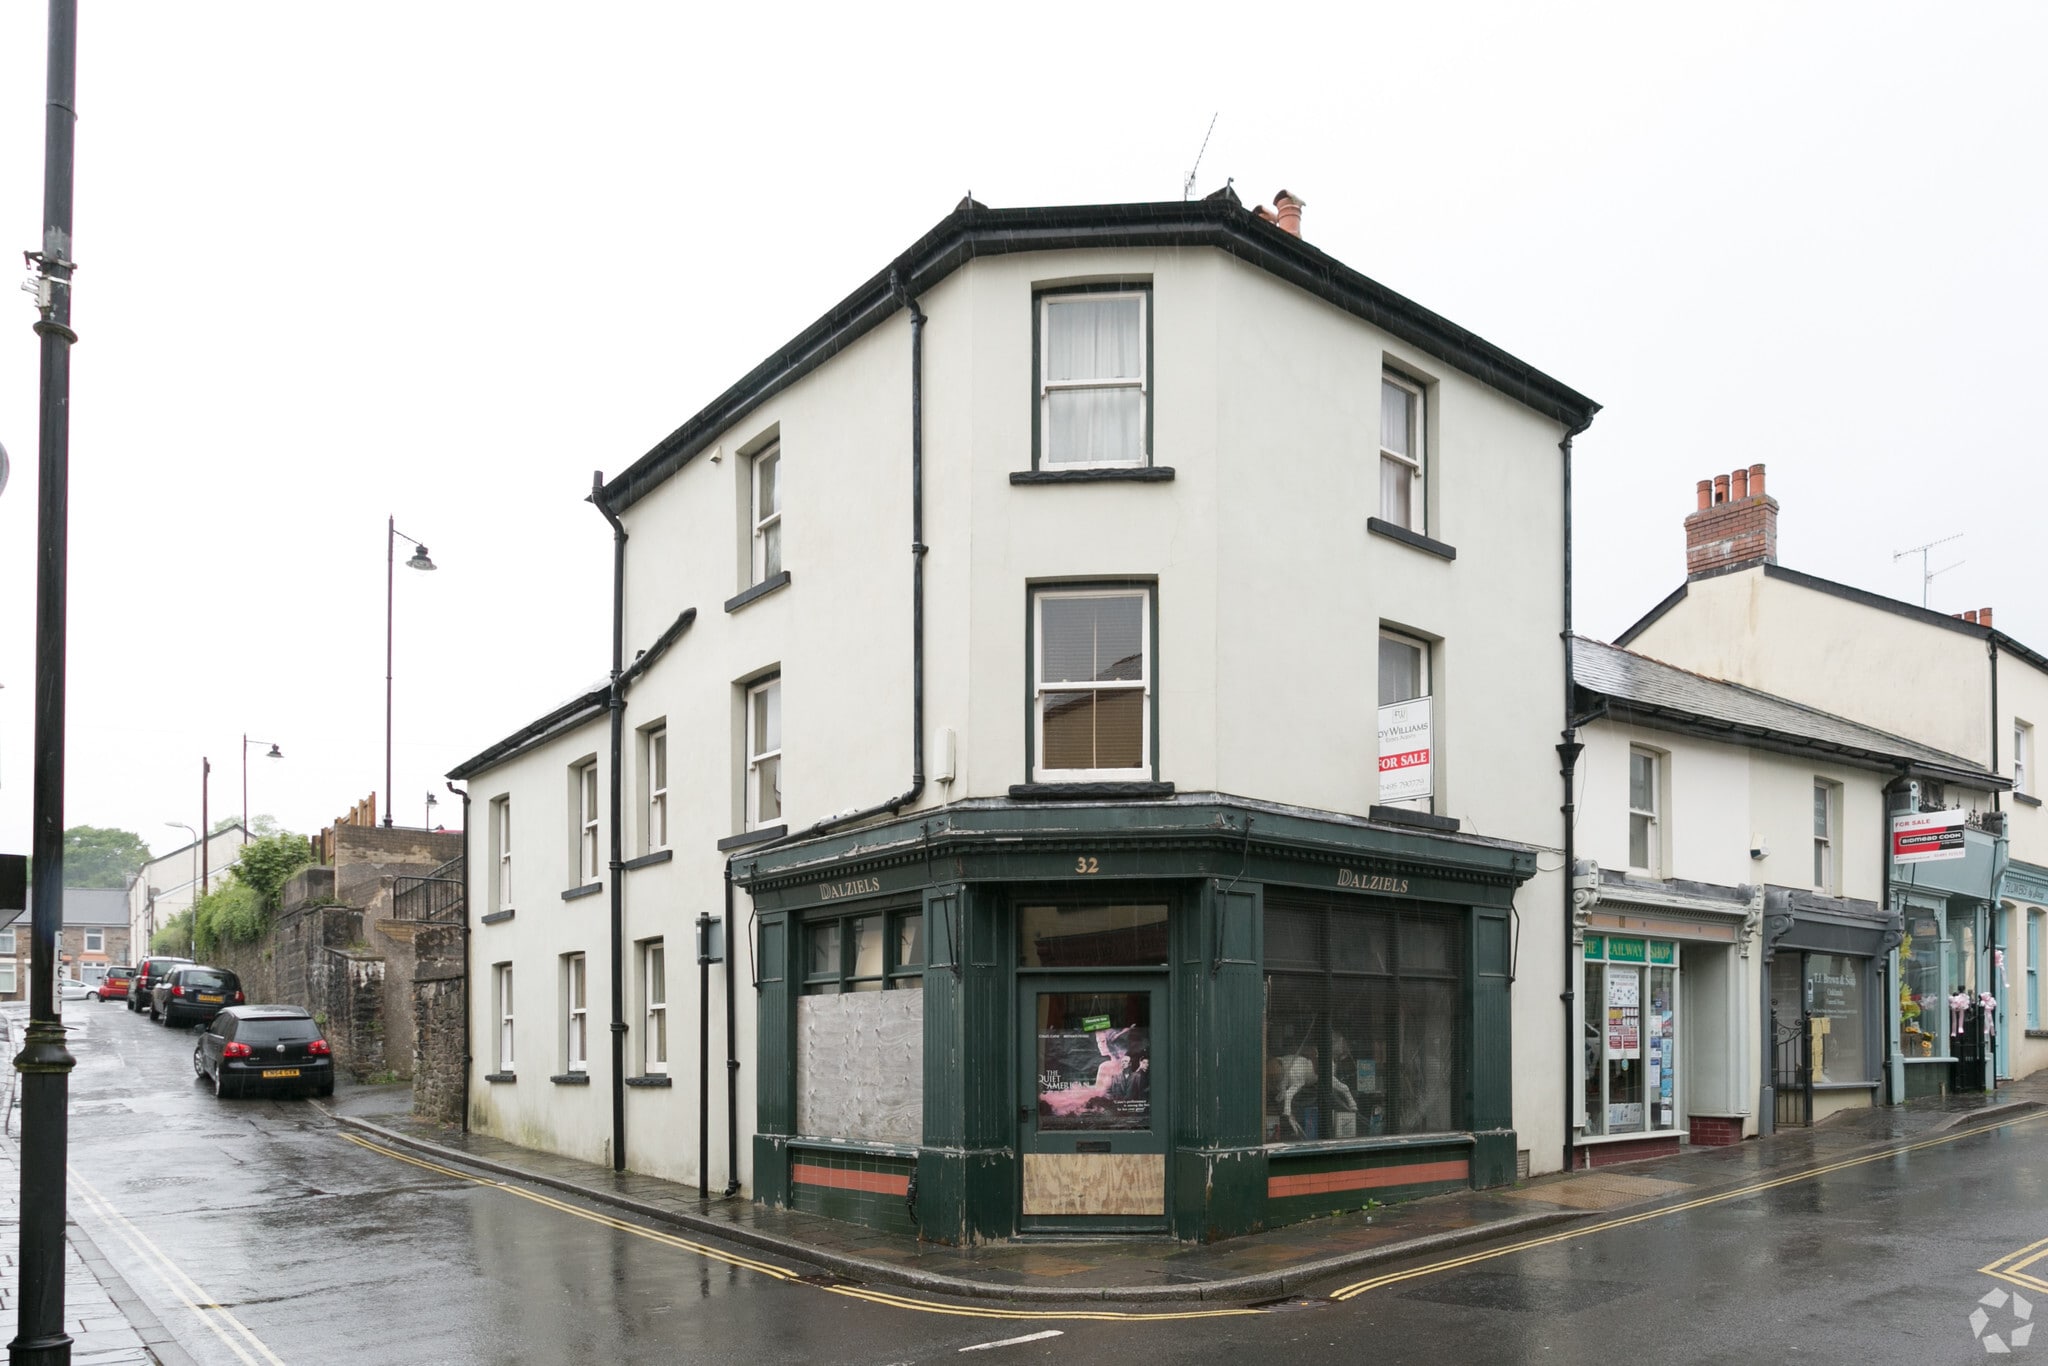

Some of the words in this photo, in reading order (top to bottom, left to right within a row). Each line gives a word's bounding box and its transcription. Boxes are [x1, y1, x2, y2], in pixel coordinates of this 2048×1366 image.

[1389, 722, 1428, 735] WILLIAMS
[1401, 752, 1427, 766] SALE
[1075, 857, 1099, 873] 32
[1337, 868, 1409, 893] DALZIELS
[819, 877, 880, 900] DALZIELS
[1585, 941, 1597, 954] HE
[1651, 946, 1670, 959] SHOP
[1047, 1069, 1058, 1077] THE
[1039, 1074, 1061, 1088] QUIET
[1047, 1081, 1090, 1090] AMERICAN
